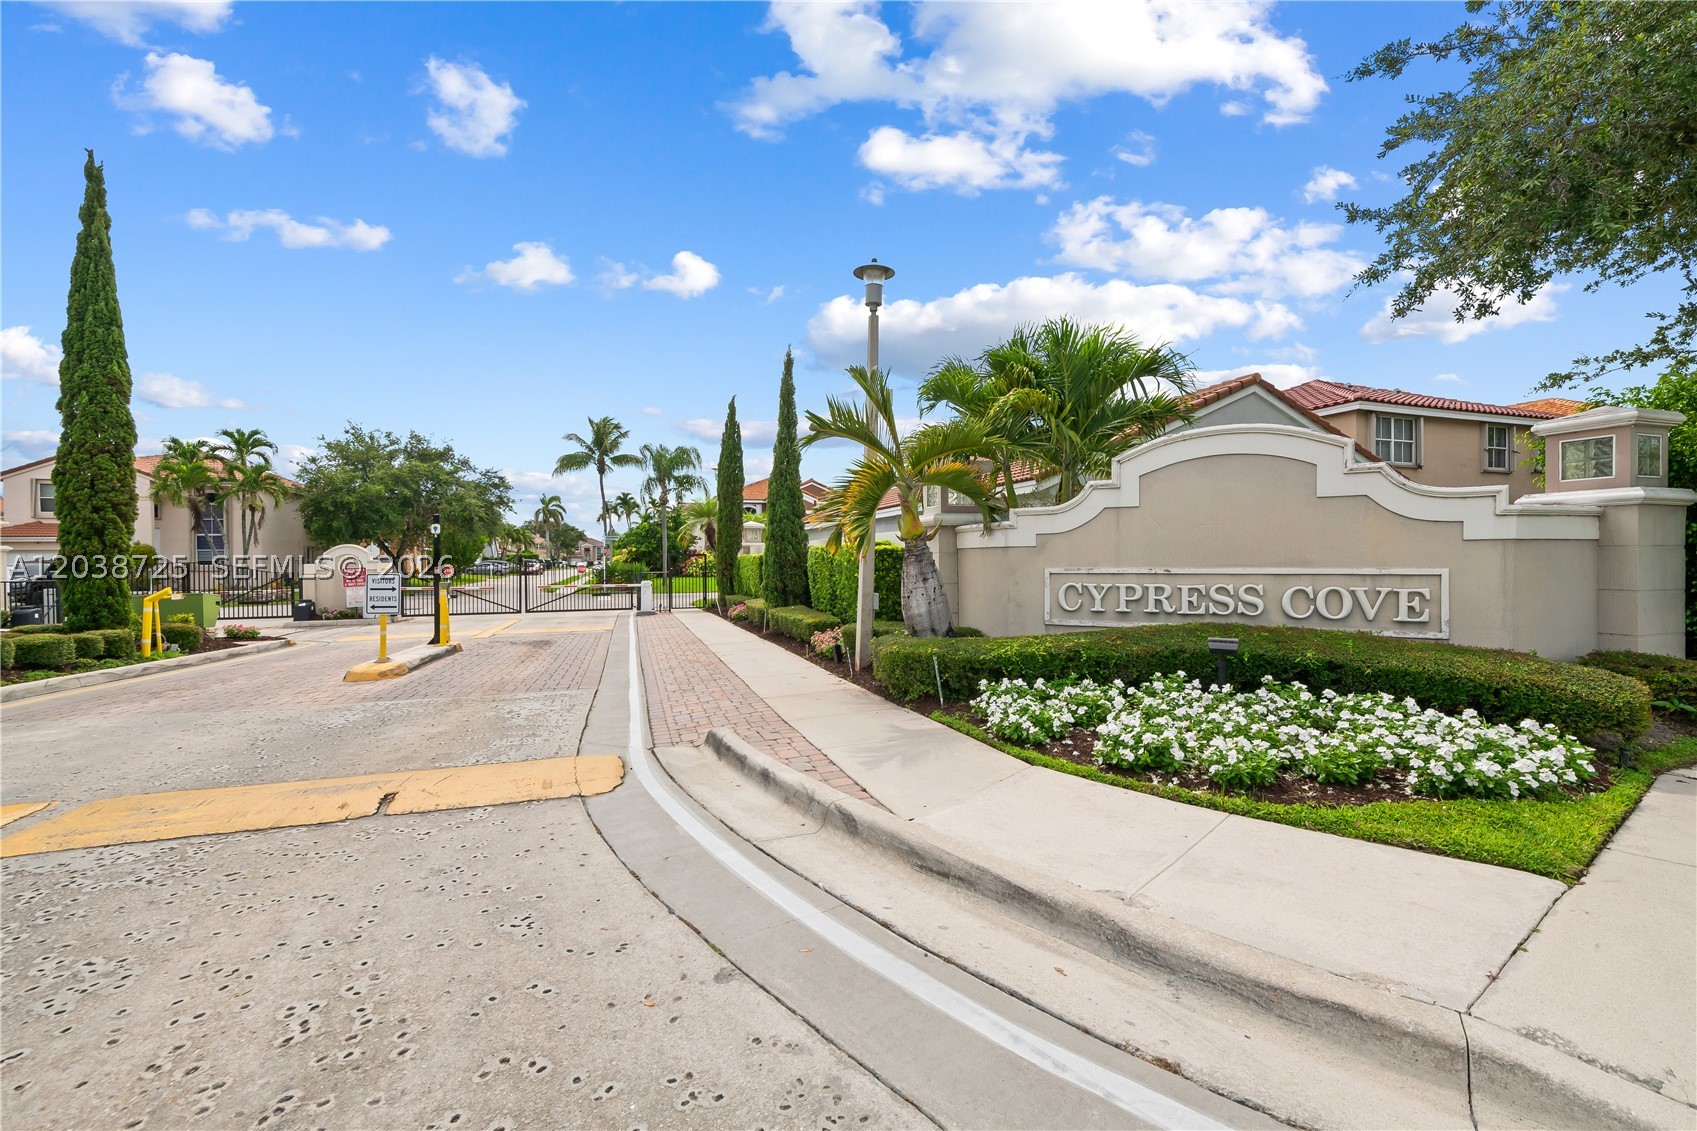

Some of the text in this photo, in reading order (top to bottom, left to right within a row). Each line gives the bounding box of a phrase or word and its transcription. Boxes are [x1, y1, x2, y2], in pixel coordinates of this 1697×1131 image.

[371, 577, 395, 585] VISITORS
[1057, 582, 1431, 622] CYPRESS COVE
